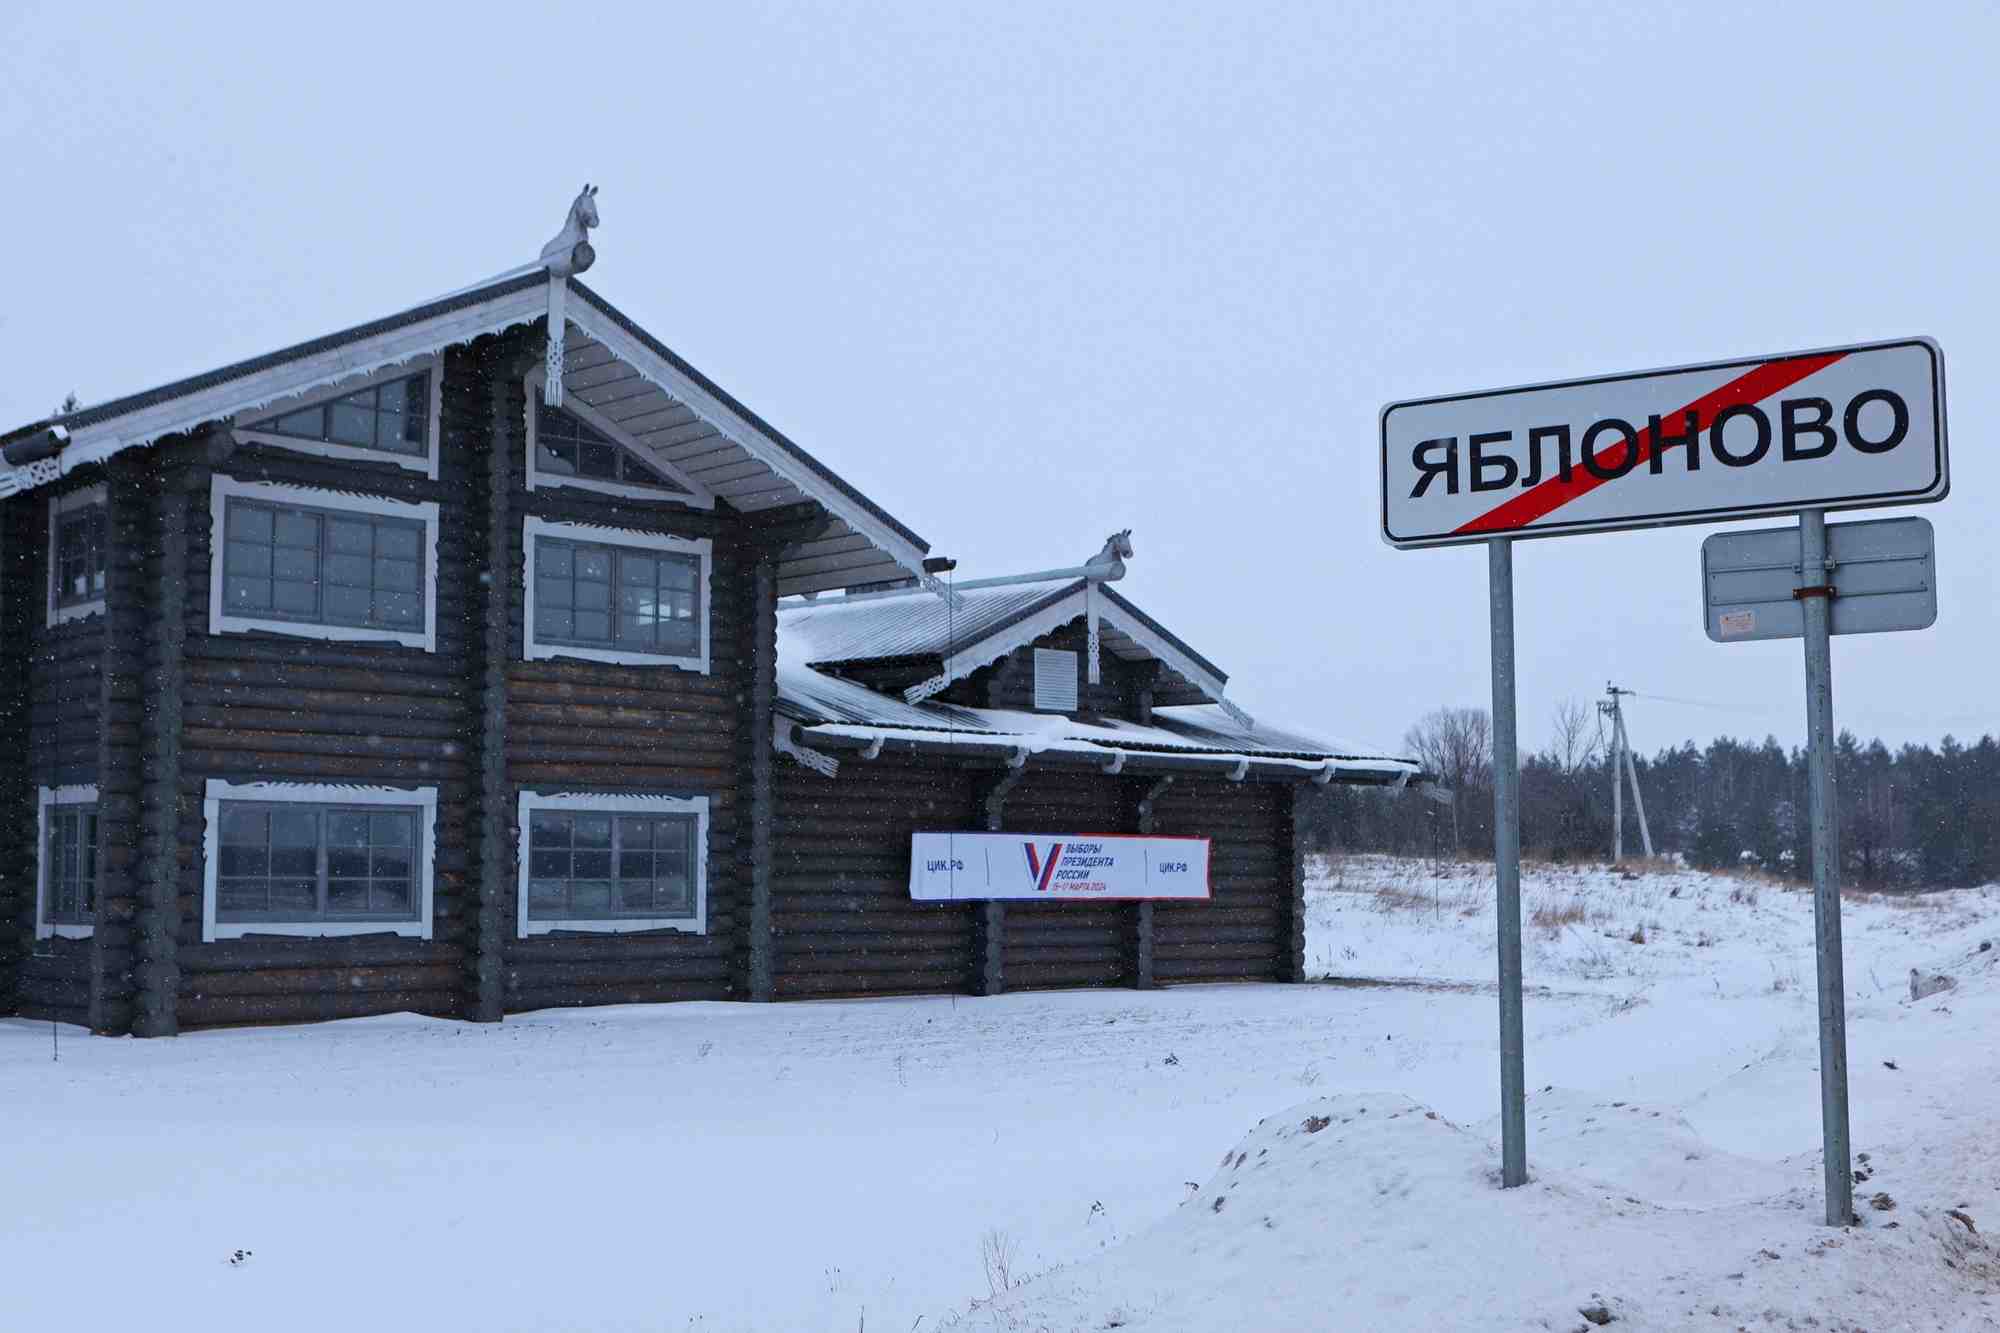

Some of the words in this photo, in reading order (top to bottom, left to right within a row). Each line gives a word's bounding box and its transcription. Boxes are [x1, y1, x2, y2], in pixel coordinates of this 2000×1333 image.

[1408, 388, 1910, 499] ЯБЛОНОВО
[1065, 843, 1102, 854] ВЫБОРЫ
[927, 859, 964, 872] ЦИК.РФ
[1061, 857, 1114, 867] ПРЕЗИДЕНТА
[1159, 862, 1188, 874] ЦИК.РФ
[1055, 869, 1090, 880] РОССИИ
